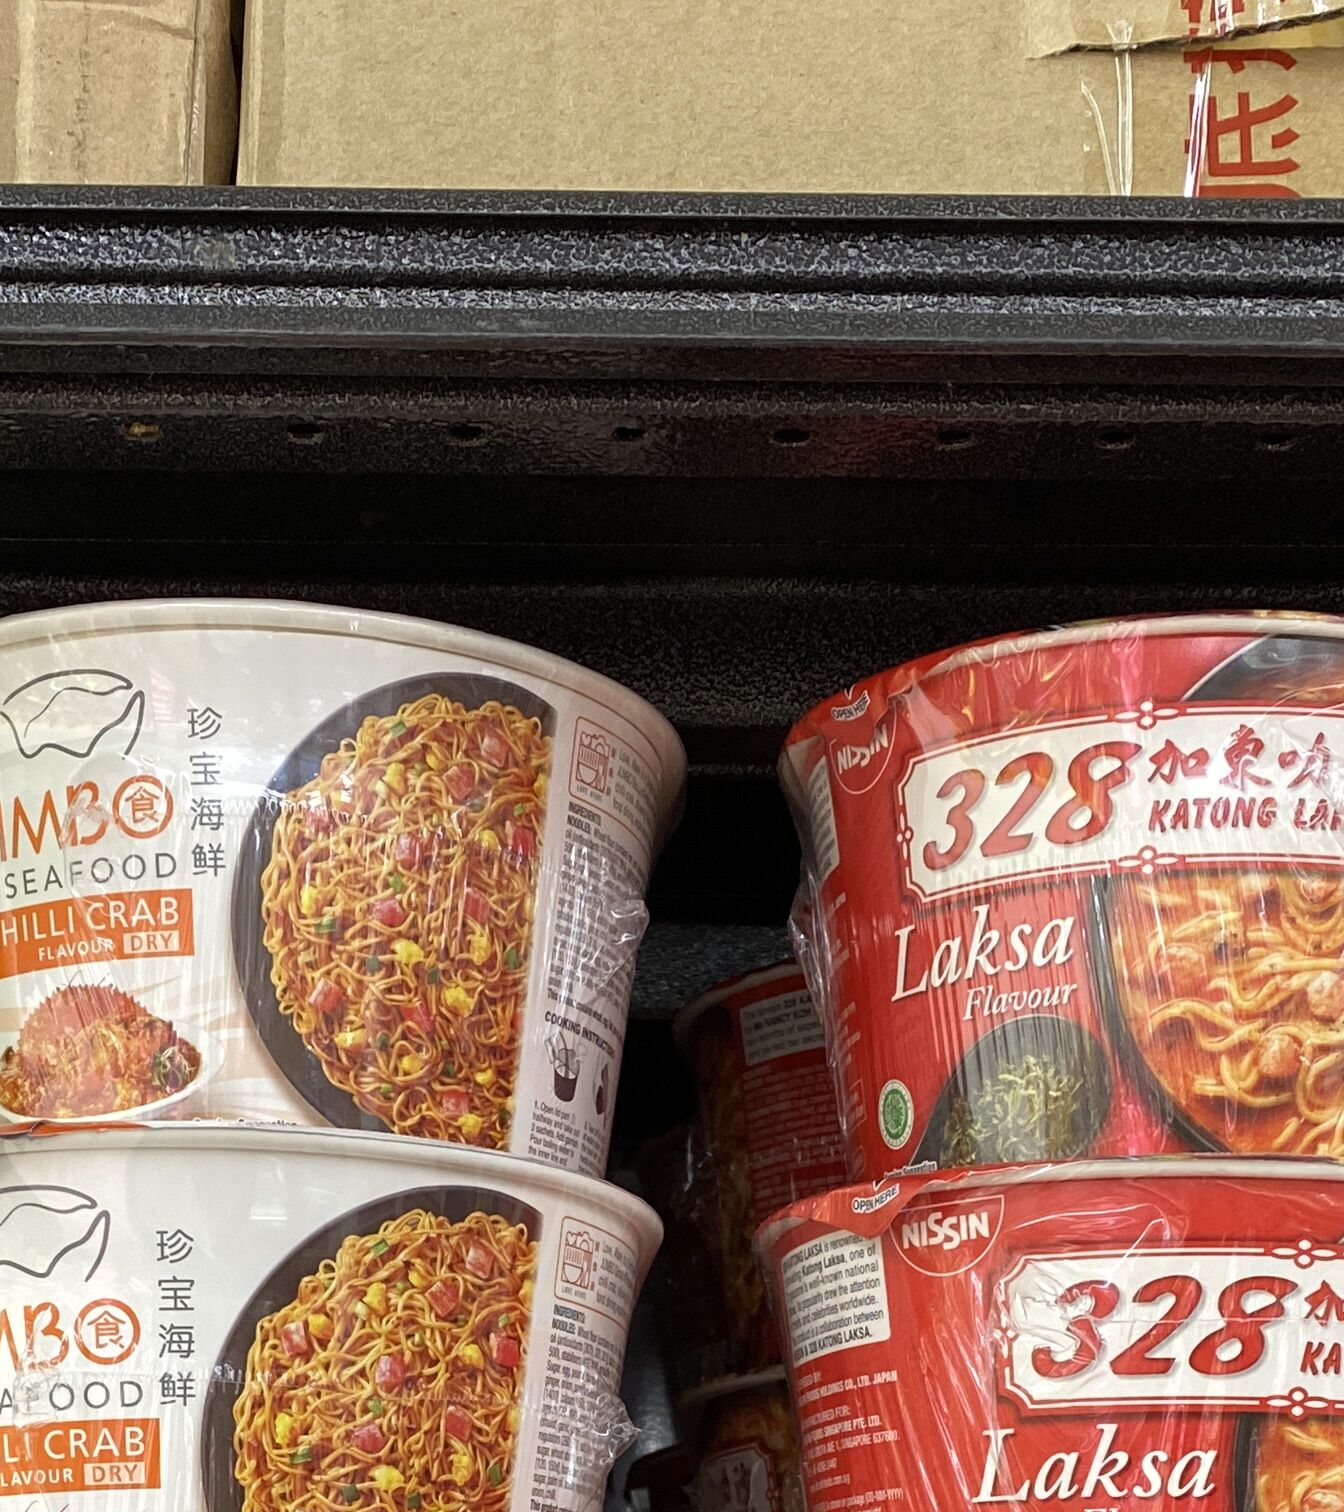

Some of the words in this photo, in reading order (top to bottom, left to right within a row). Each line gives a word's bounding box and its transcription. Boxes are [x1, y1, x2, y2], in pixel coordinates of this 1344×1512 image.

[187, 706, 226, 878] 珍宝海鲜
[922, 740, 1143, 874] 328
[1148, 795, 1277, 835] KATONG
[5, 852, 177, 898] SEAFOOD
[88, 896, 180, 932] CRAB
[38, 939, 115, 963] FLAVOUR
[130, 932, 174, 953] DRY
[892, 904, 1074, 1002] Laksa
[963, 980, 1078, 1021] Flavour
[853, 1199, 873, 1211] OPEN
[874, 1188, 897, 1207] HERE
[901, 1210, 991, 1251] NISSIN
[156, 1229, 196, 1407] 珍宝海鲜
[1031, 1274, 1298, 1381] 328
[44, 1424, 146, 1460] CRAB
[92, 1464, 138, 1484] DRY
[973, 1423, 1217, 1504] Laksa
